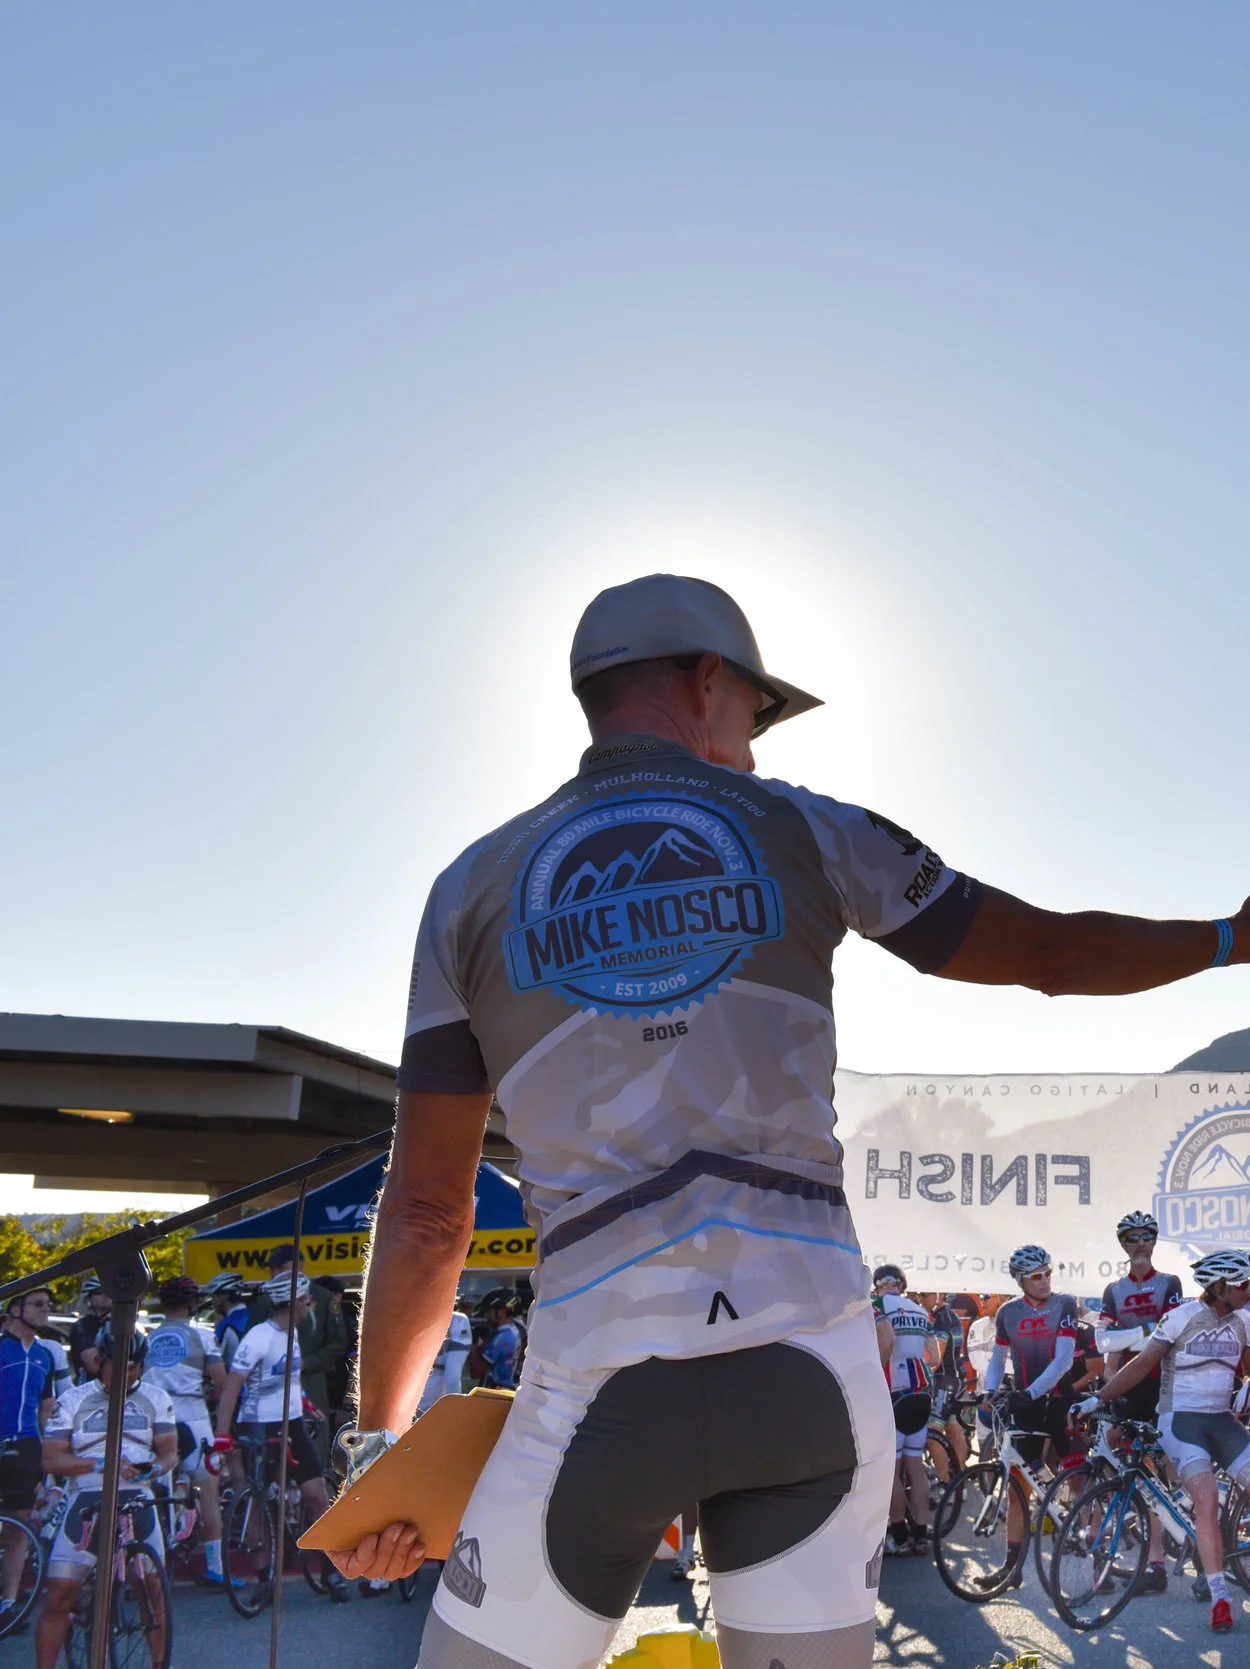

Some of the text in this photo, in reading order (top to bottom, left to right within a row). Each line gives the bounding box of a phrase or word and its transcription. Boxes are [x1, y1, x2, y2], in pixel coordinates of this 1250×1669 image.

[530, 794, 581, 828] CREEK
[593, 772, 710, 793] MULHOLLAND
[719, 787, 767, 818] LATIGO
[530, 847, 562, 911] ANNUAL
[560, 831, 576, 847] 80
[575, 811, 614, 834] MILE
[615, 806, 682, 820] BICYCLE
[682, 809, 712, 832] RIDE
[524, 882, 767, 982] MIKE NOSCO
[600, 941, 699, 969] MEMORIAL
[614, 972, 688, 997] EST 2009
[642, 1020, 689, 1042] 2016
